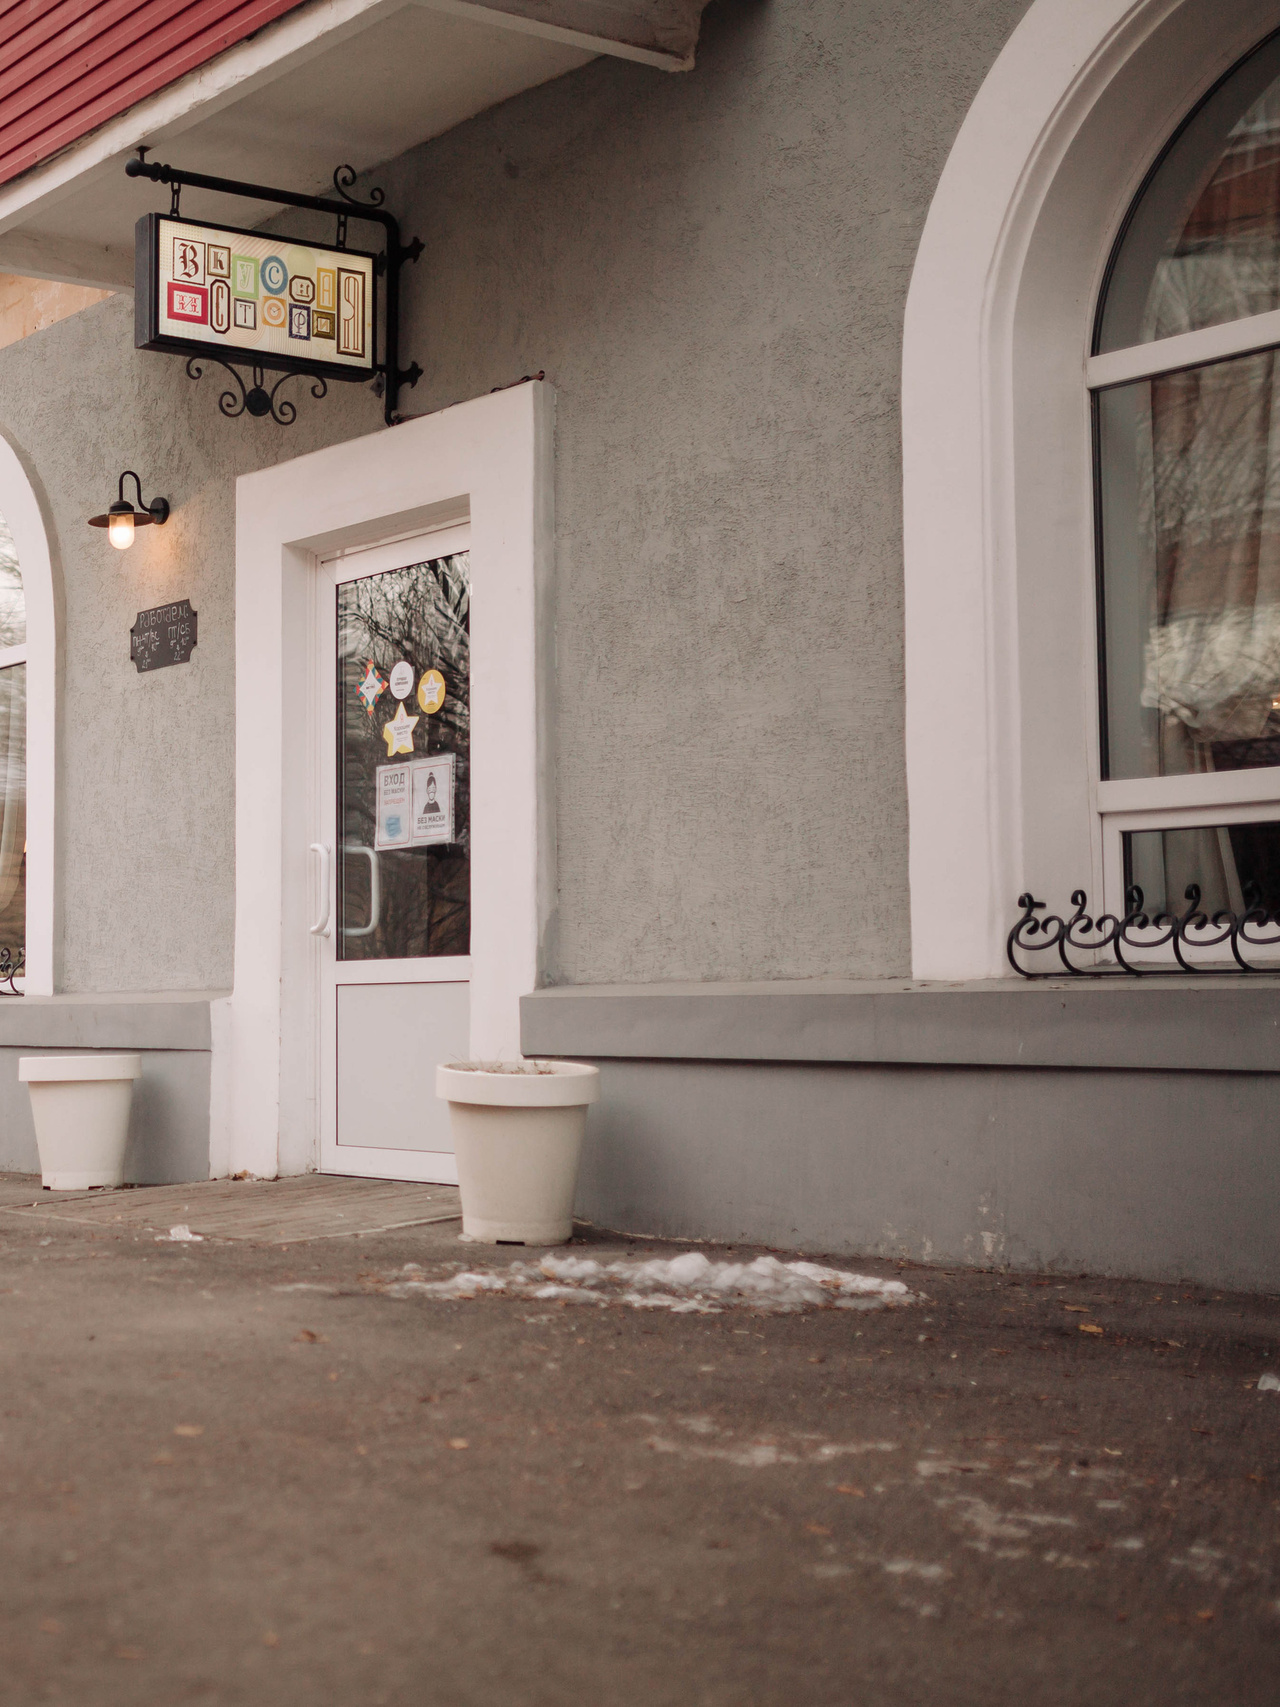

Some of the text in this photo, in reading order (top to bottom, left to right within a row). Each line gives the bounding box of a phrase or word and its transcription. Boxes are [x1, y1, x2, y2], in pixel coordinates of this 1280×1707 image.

[383, 773, 405, 787] ВХОД
[417, 814, 445, 825] БЕЗ МАСКИ
